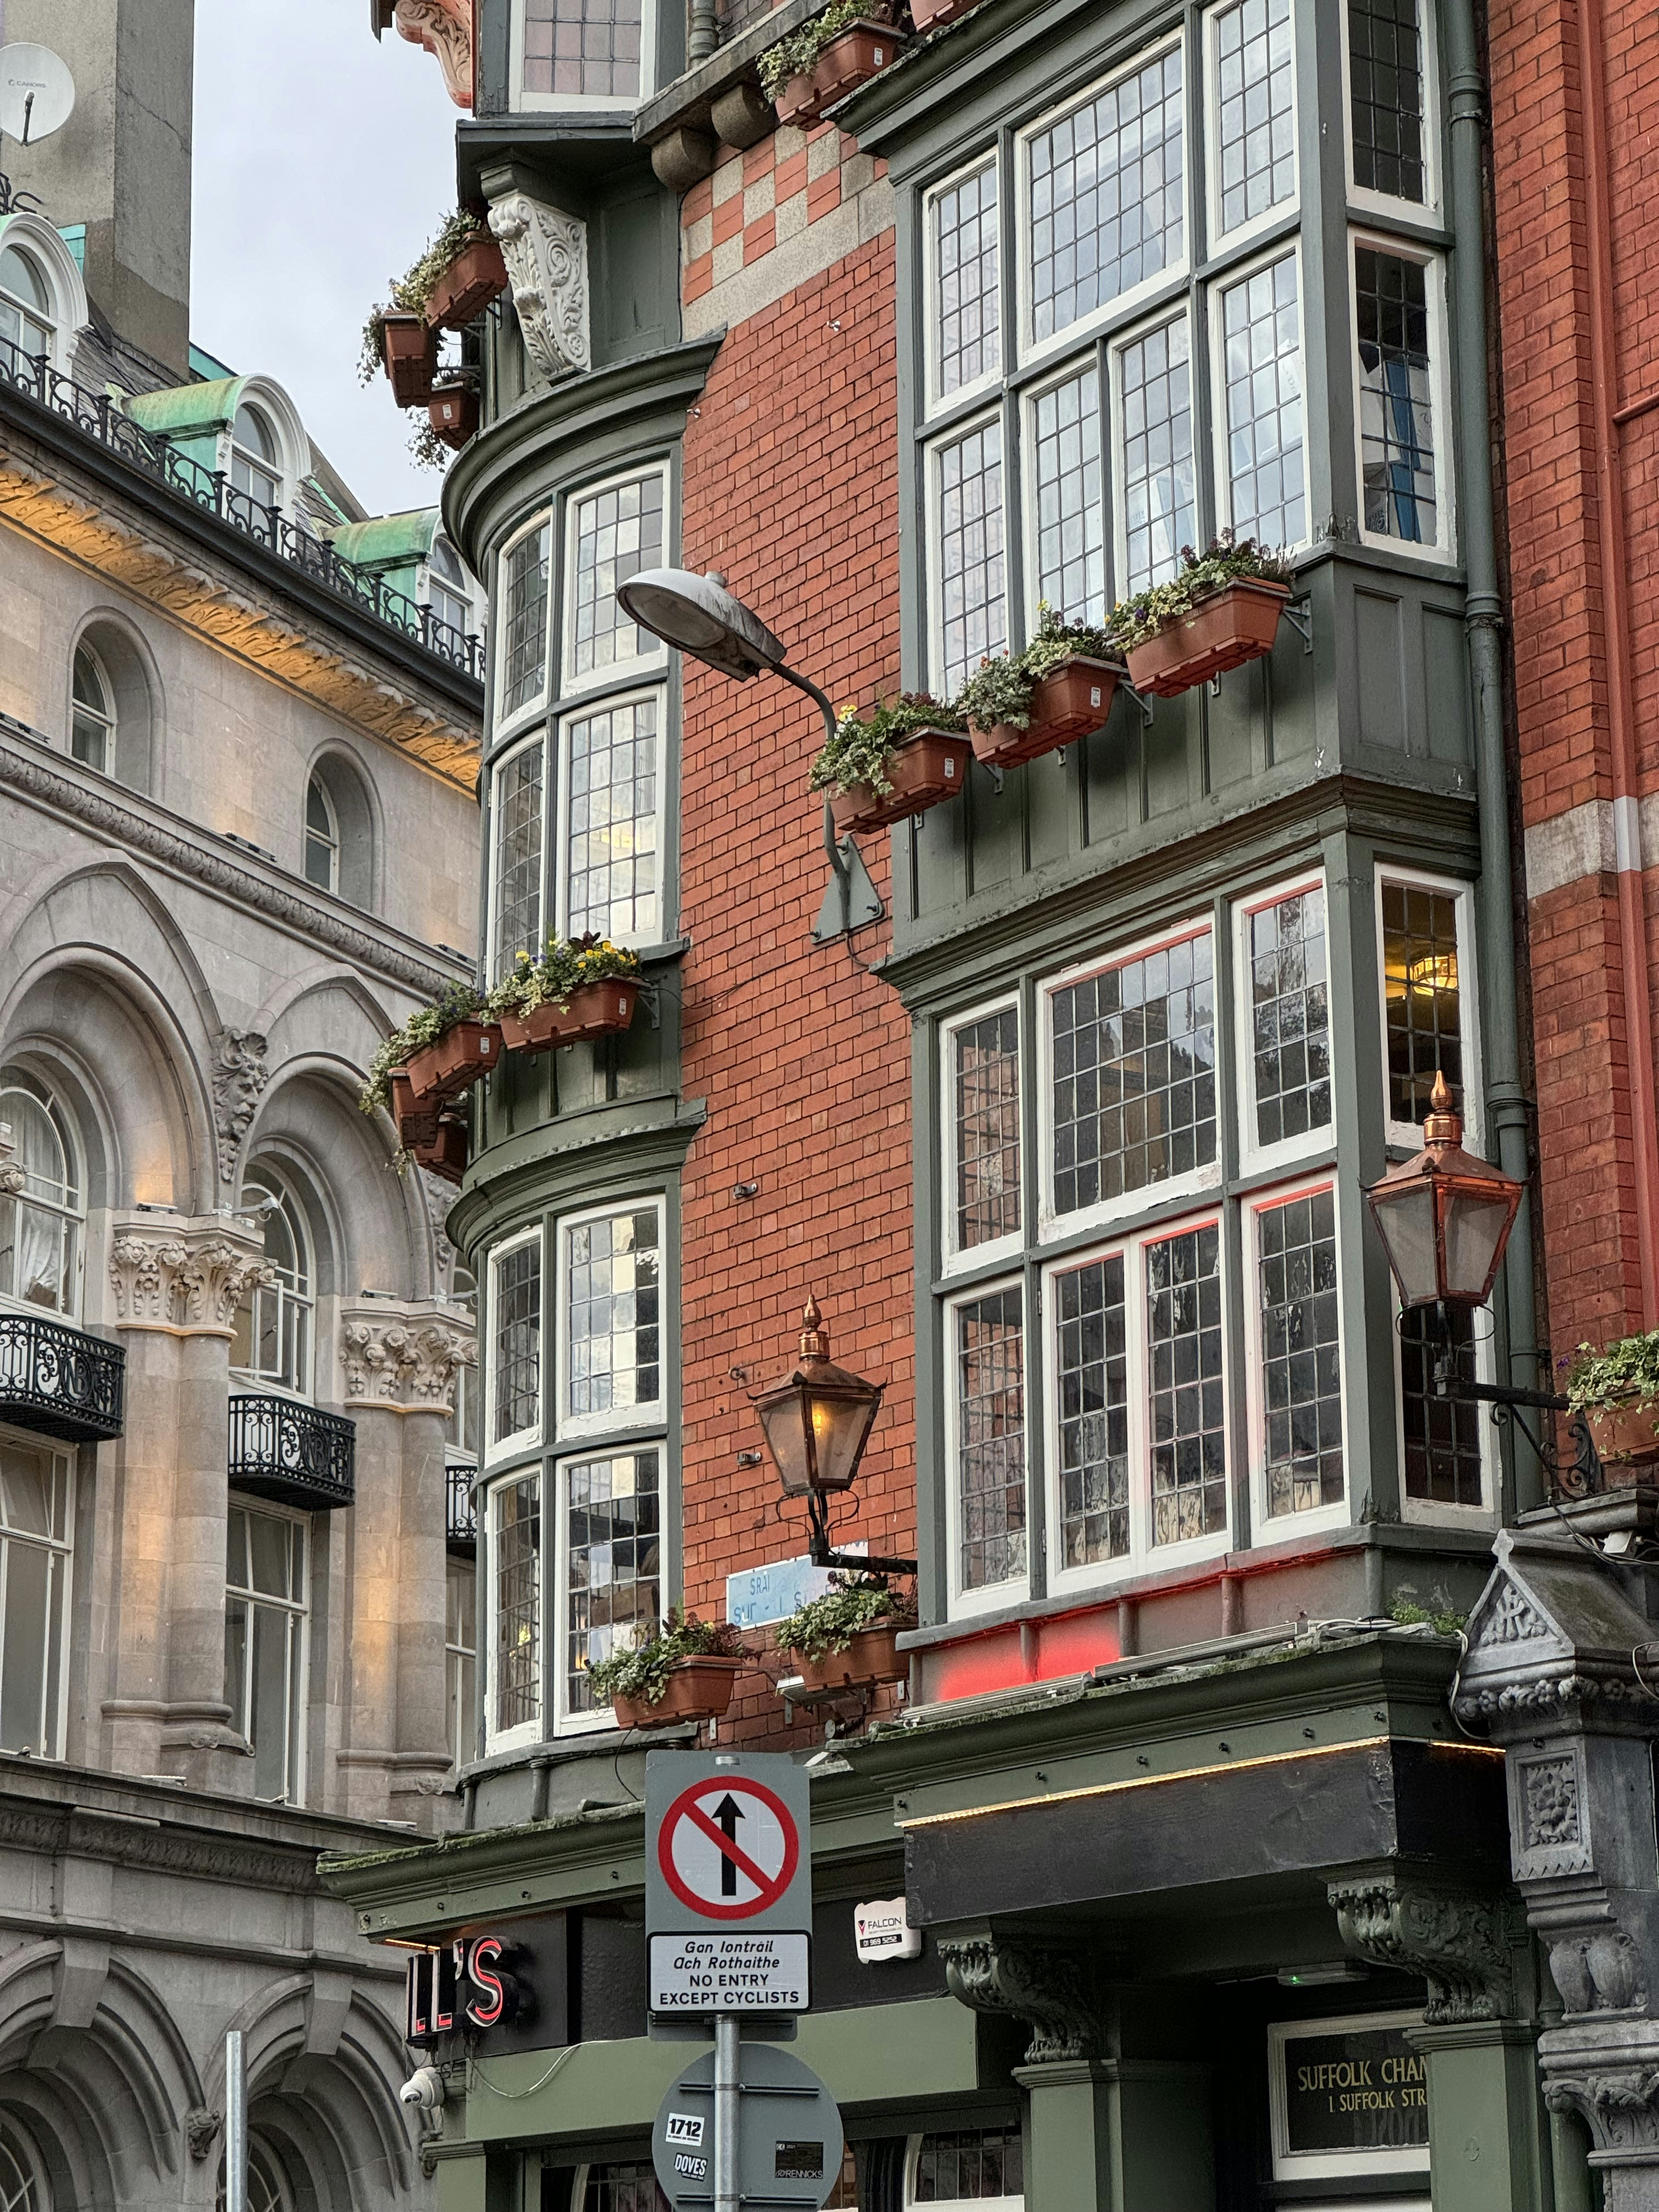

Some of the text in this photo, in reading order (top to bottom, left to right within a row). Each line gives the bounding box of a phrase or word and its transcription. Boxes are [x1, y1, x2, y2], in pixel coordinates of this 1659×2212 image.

[868, 1917, 901, 1929] FALCON
[685, 1940, 774, 1954] Gan Iontráil
[882, 1936, 897, 1944] 5252
[708, 1956, 780, 1968] Rothaithe
[690, 1974, 769, 1987] NO ENTRY
[660, 1991, 799, 2005] EXCEPT CYCLISTS
[1298, 2061, 1373, 2091] SUFFOLK
[1339, 2090, 1395, 2112] SUFFOLK
[669, 2118, 701, 2137] 1712
[674, 2154, 707, 2176] DOVES
